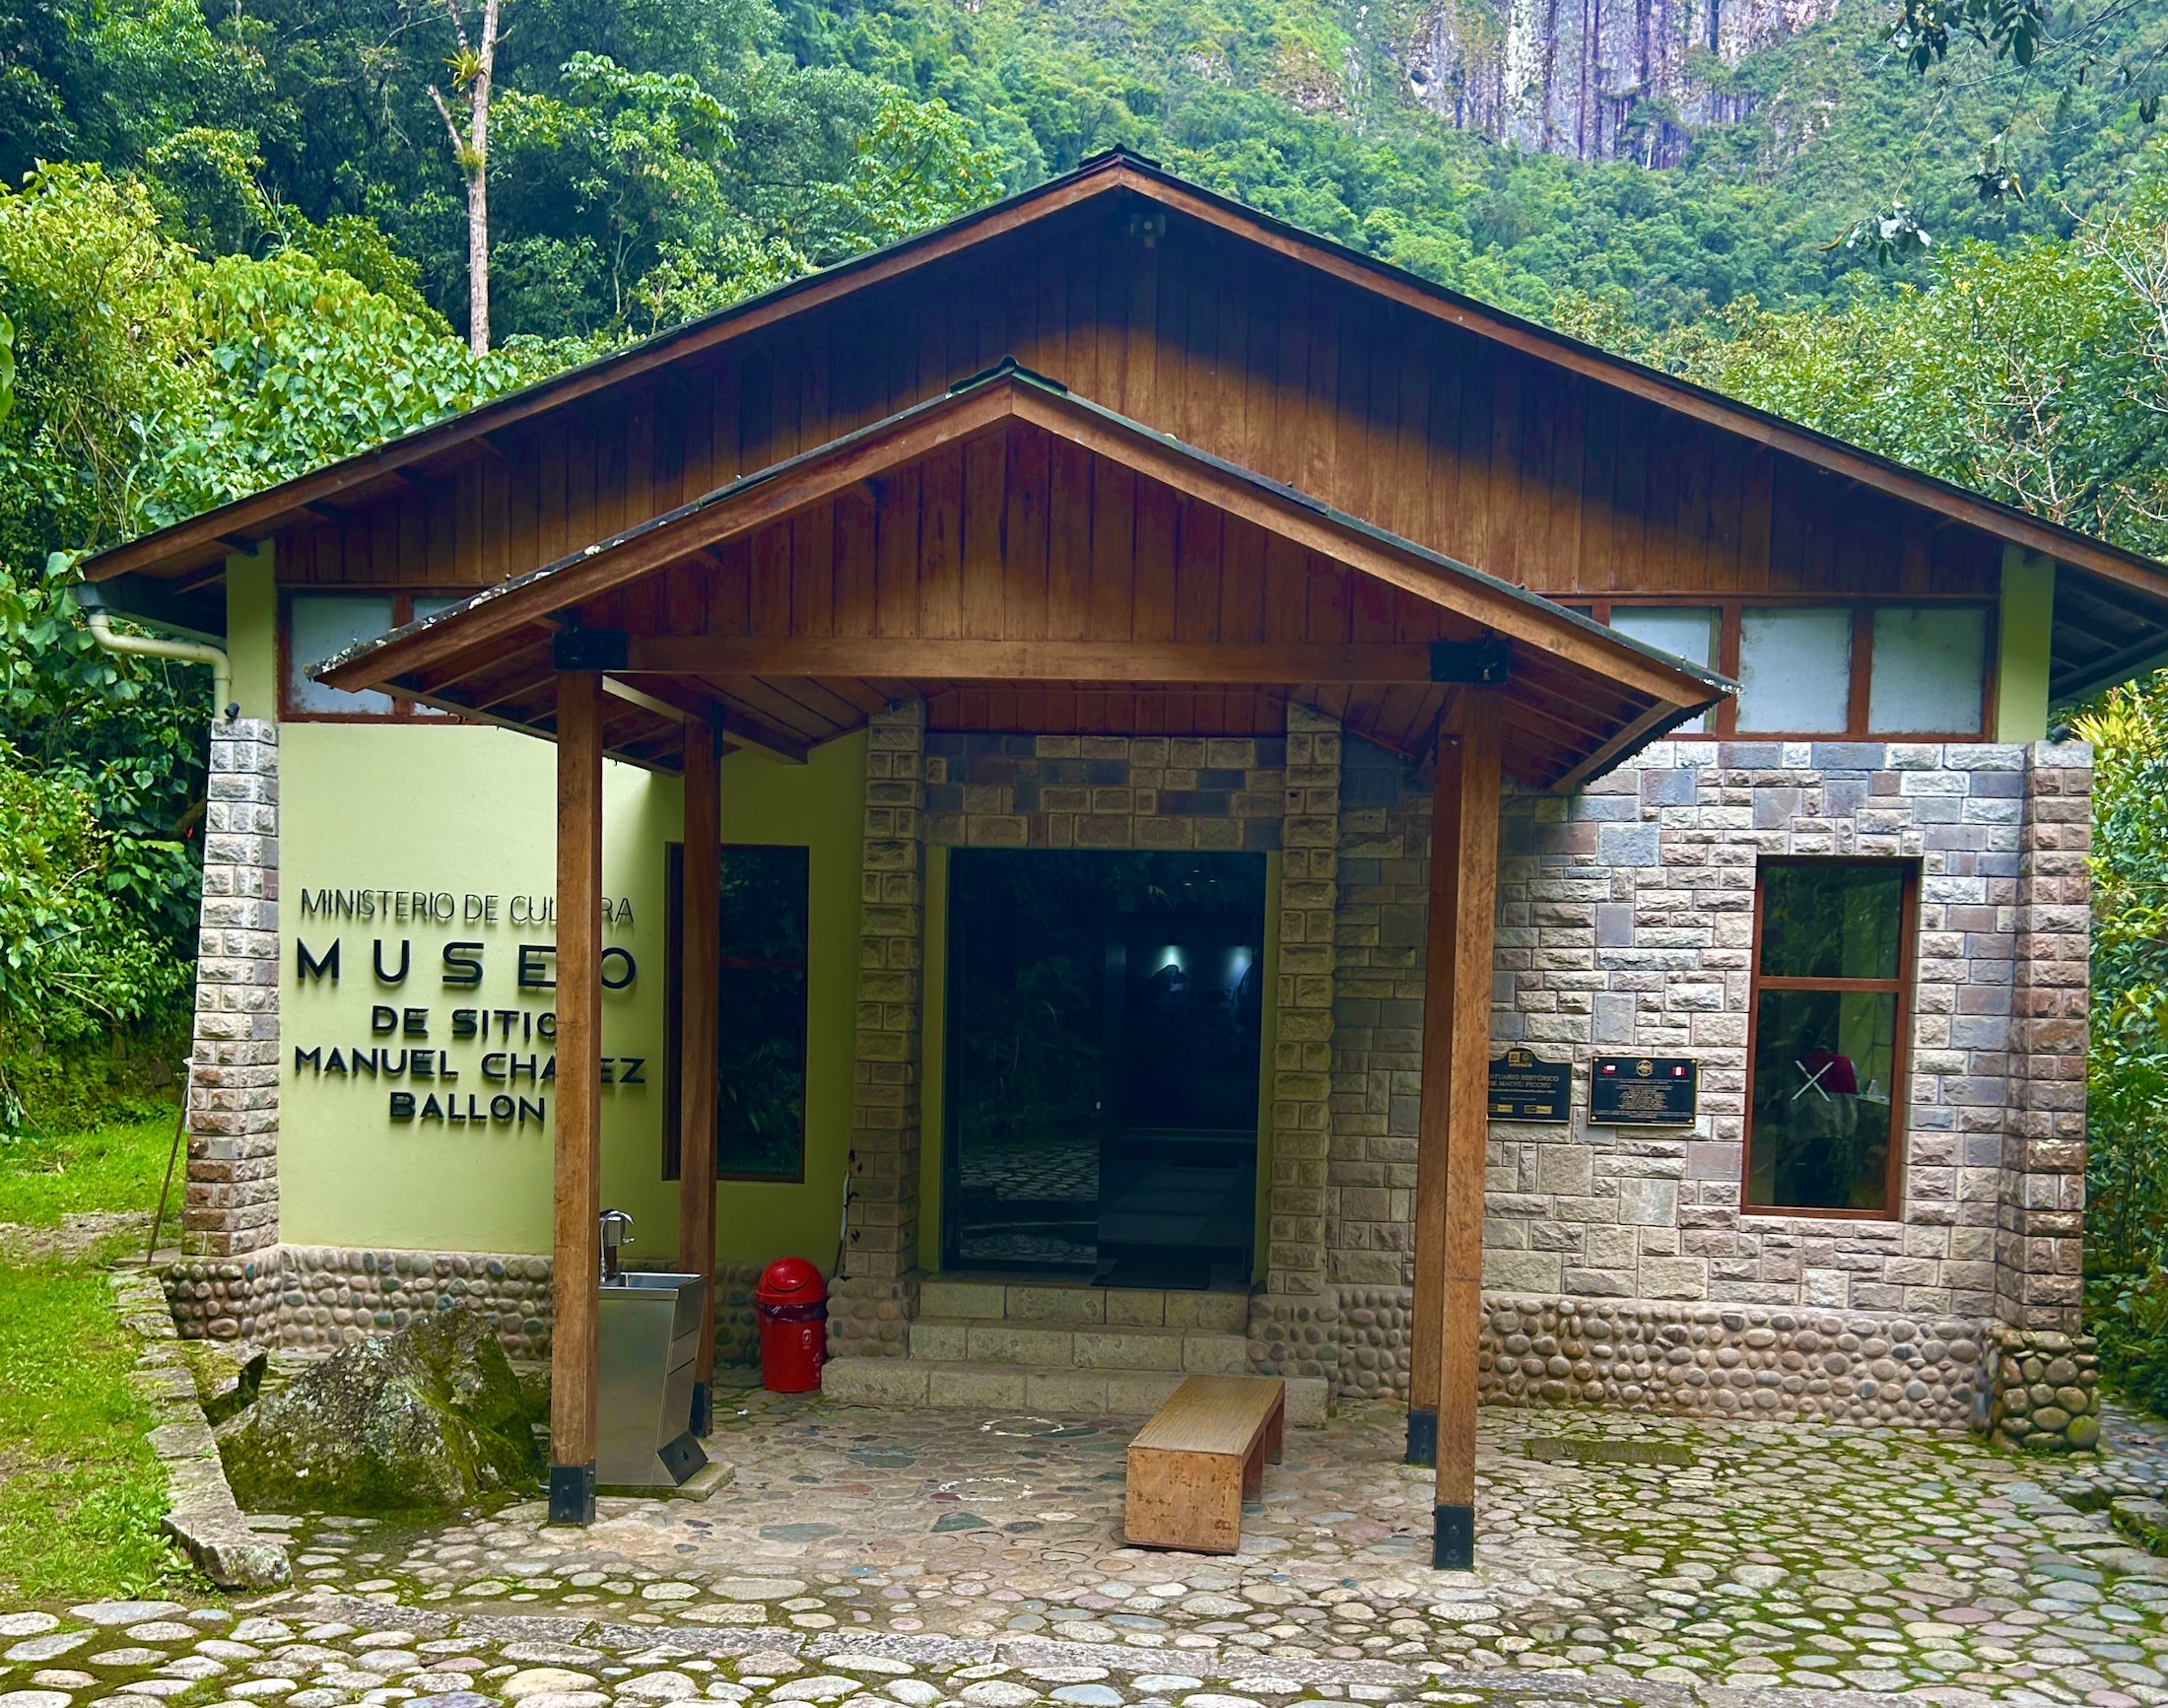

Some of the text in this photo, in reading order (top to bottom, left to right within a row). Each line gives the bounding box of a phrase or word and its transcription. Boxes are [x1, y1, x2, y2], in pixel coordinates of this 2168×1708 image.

[302, 888, 635, 923] MINISTERIO DE CULRA
[297, 937, 637, 990] MUSEO
[372, 1004, 556, 1040] DE SITIO
[295, 1046, 646, 1084] MANUEL CHAEZ
[389, 1091, 545, 1124] BALLON
